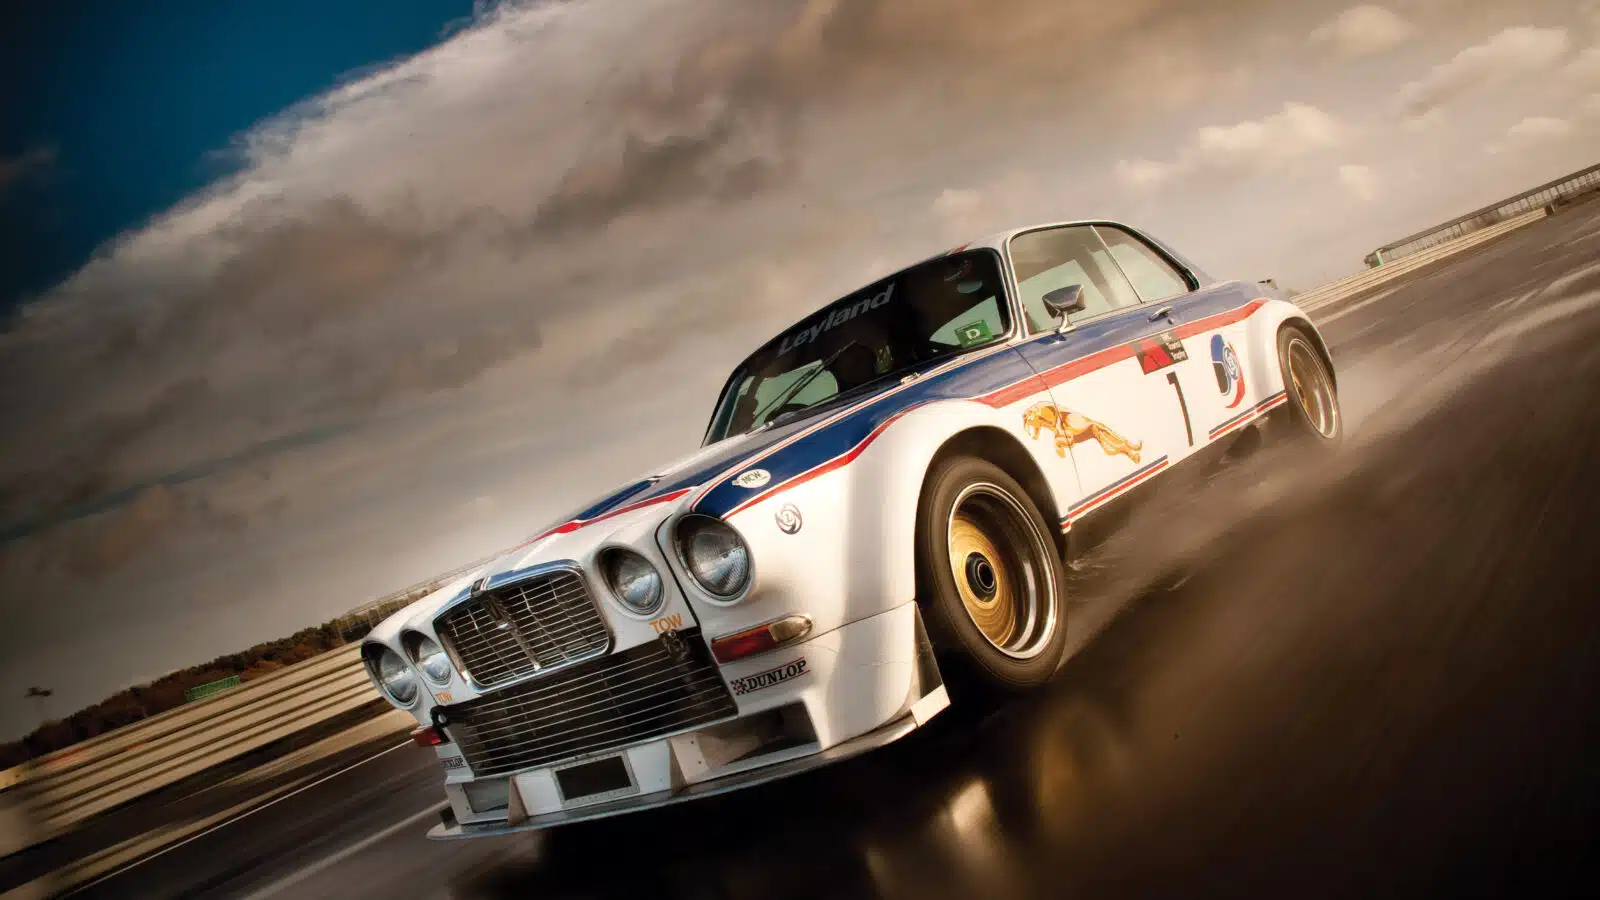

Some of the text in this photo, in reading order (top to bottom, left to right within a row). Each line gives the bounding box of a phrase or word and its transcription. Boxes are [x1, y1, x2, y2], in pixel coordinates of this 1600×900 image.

[777, 281, 896, 357] Leyland
[966, 328, 981, 340] D
[1166, 371, 1194, 447] 1
[648, 612, 683, 634] TOW
[747, 659, 807, 690] DUNLOP
